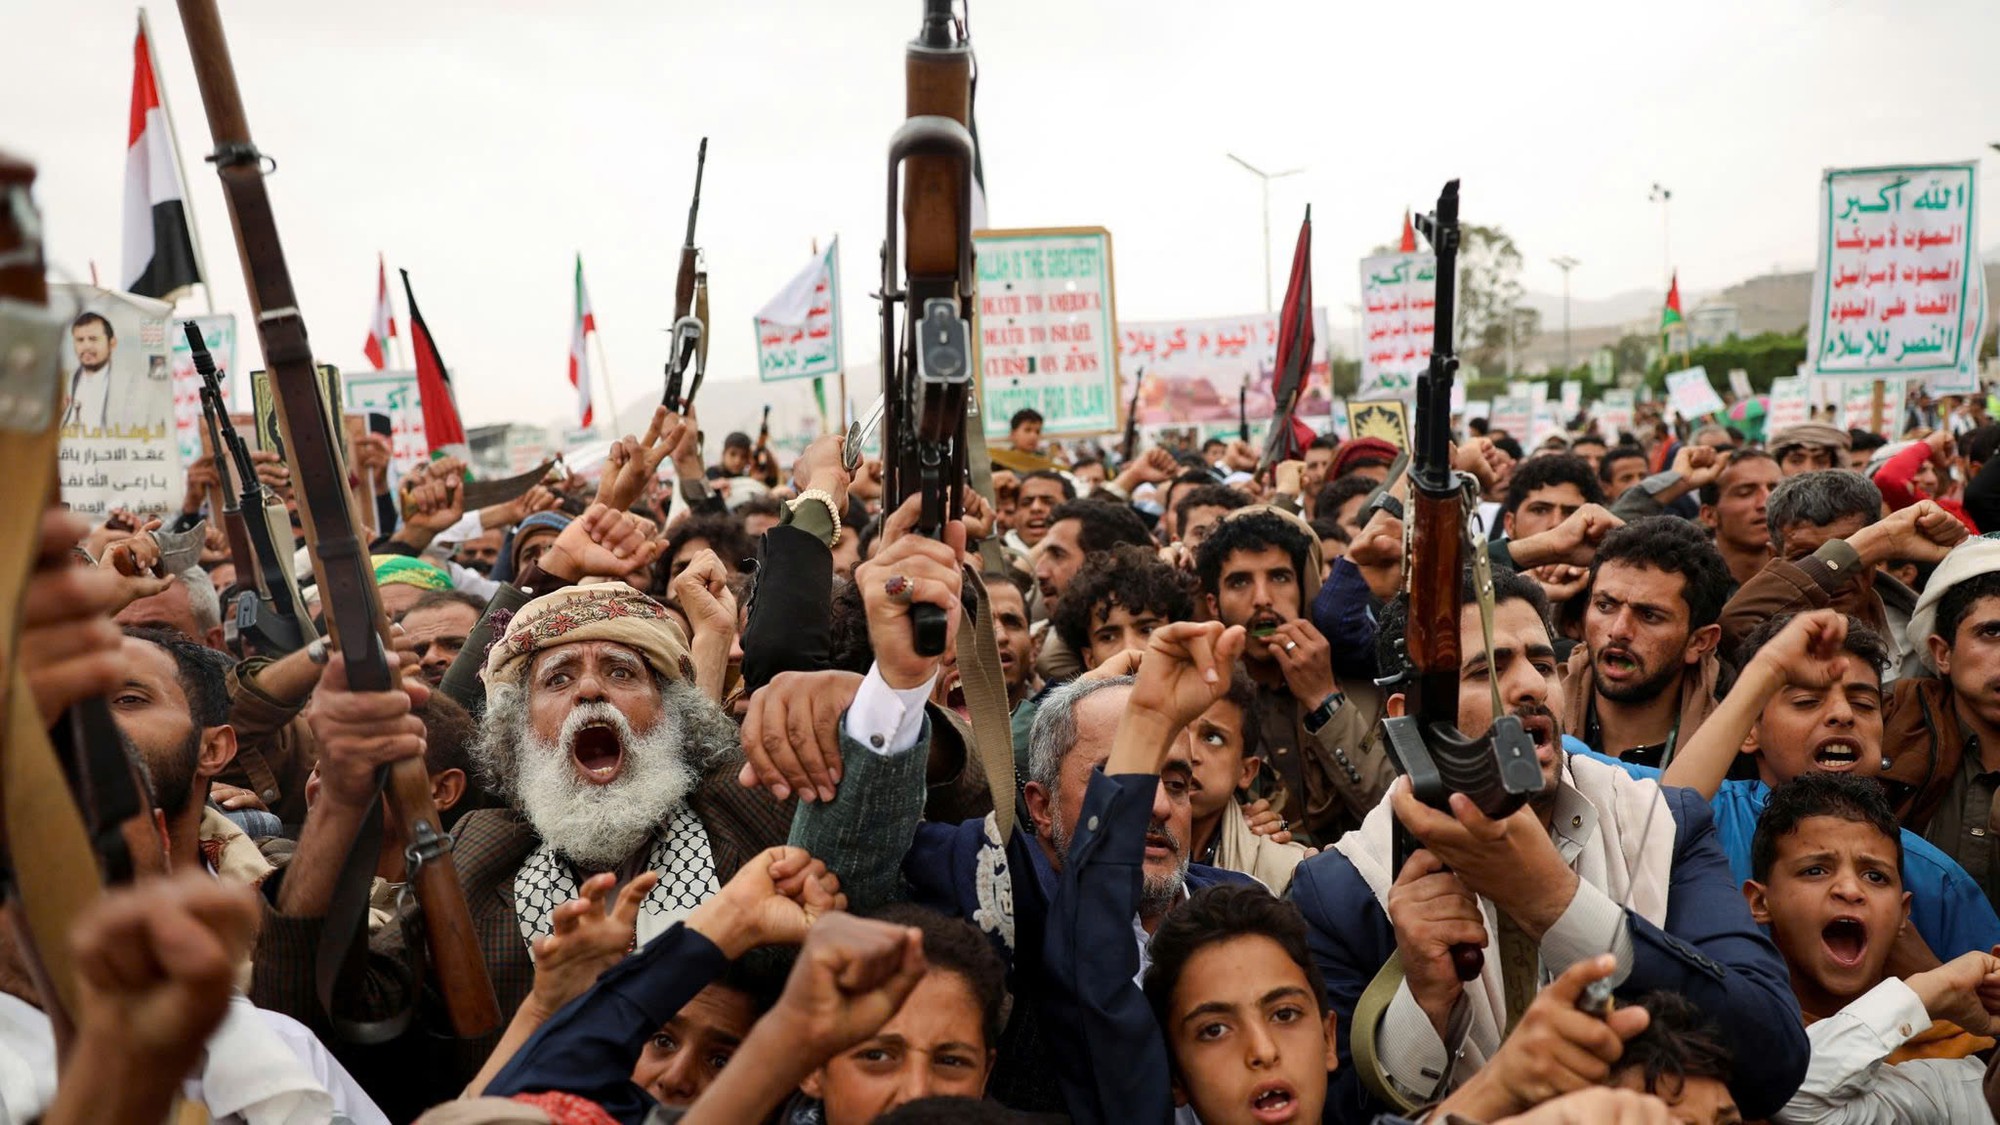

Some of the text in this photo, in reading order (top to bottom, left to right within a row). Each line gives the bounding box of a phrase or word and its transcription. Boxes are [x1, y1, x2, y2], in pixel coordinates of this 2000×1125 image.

[1837, 175, 1964, 224] الله أكبر
[1903, 224, 1962, 252] الموت
[1902, 259, 1959, 285] الموت
[982, 294, 1022, 315] DEATH
[1026, 294, 1043, 314] TO
[1831, 292, 1957, 323] اللعنة على اليهود
[984, 323, 1092, 345] DEATH TO ISRAEL
[1198, 323, 1257, 357] اليوم
[1894, 323, 1953, 362] النصر
[1040, 354, 1058, 373] ON
